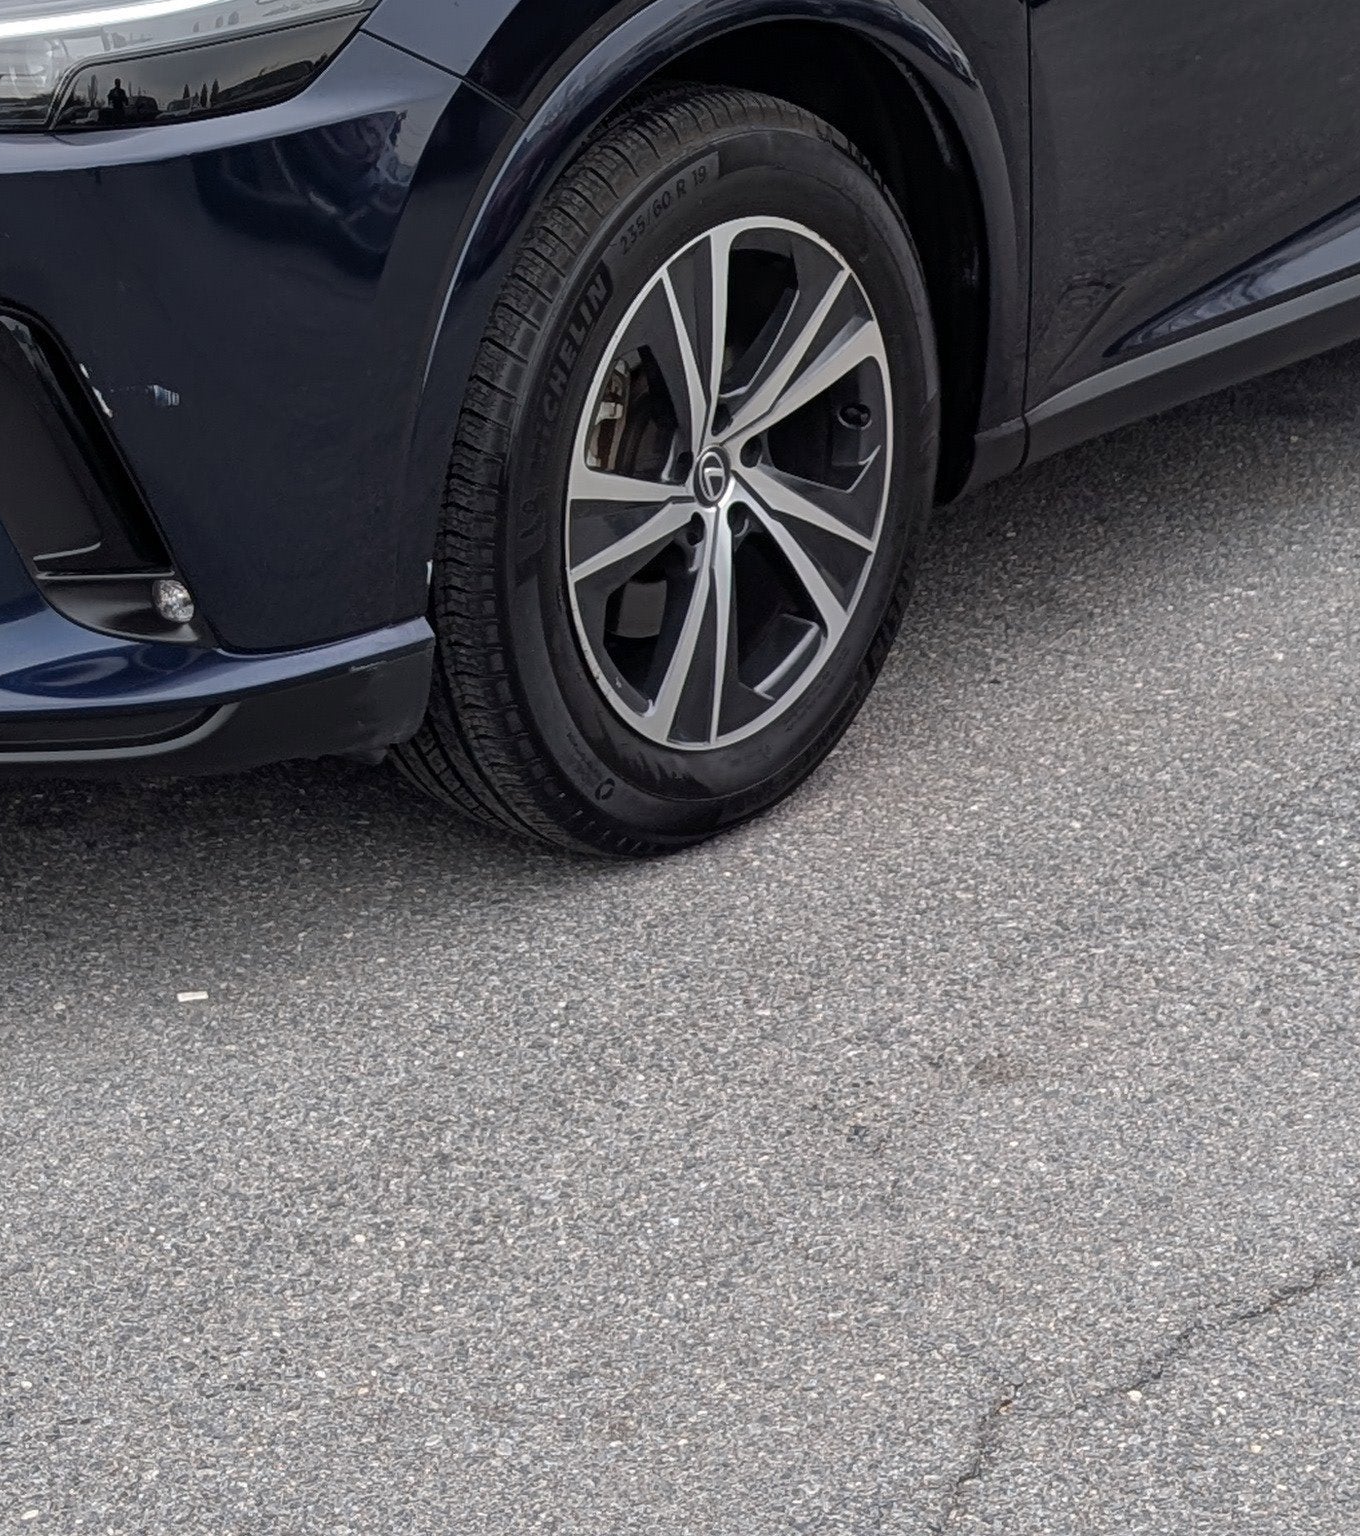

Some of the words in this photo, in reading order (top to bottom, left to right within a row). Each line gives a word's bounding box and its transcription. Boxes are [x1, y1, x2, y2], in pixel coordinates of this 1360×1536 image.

[620, 190, 671, 255] 235/60
[676, 178, 687, 199] R
[691, 165, 707, 186] 19
[533, 271, 609, 464] CHELIN
